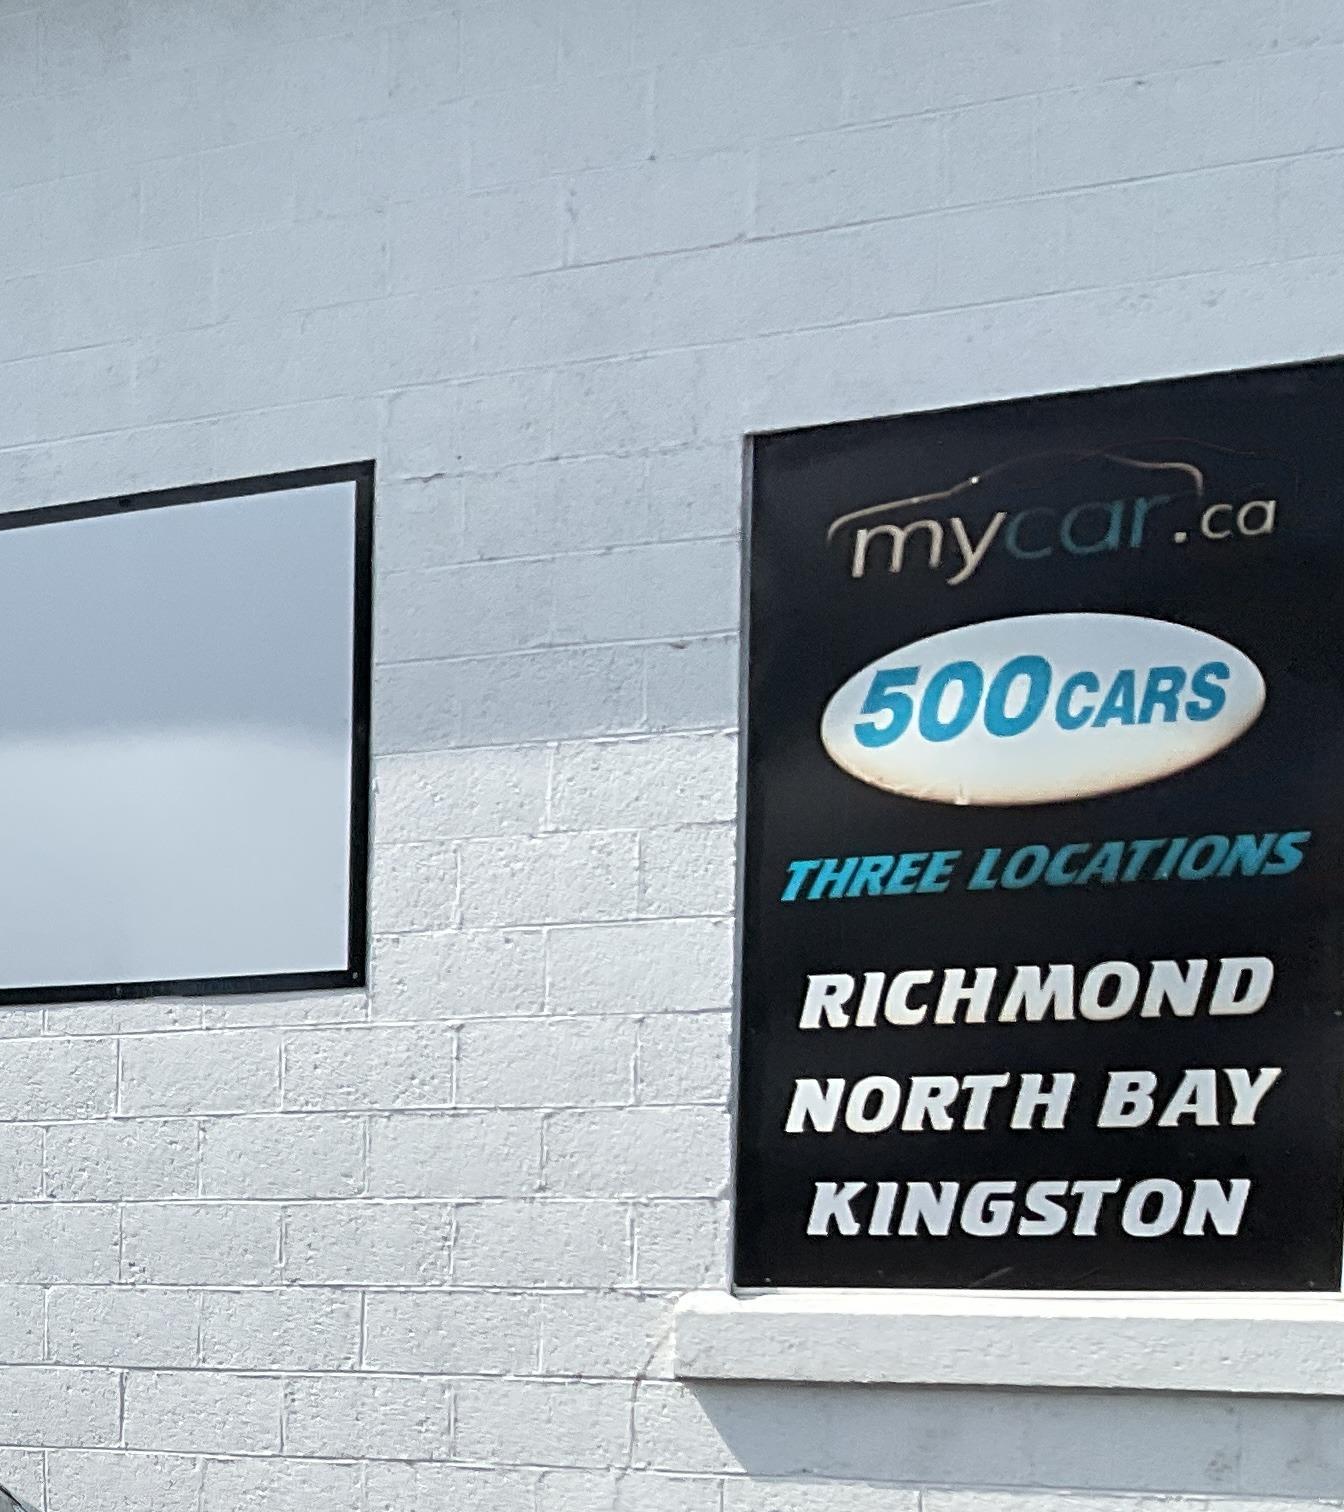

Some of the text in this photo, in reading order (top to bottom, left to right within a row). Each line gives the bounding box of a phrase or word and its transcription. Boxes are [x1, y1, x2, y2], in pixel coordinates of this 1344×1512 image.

[851, 492, 1277, 586] mycar.ca
[853, 655, 1231, 749] 500 CARS
[780, 830, 1313, 903] THREE LOCATIONS
[798, 956, 1275, 1030] RICHMOND
[785, 1066, 1282, 1134] NORTH BAY
[805, 1178, 1252, 1238] KINGSTON
